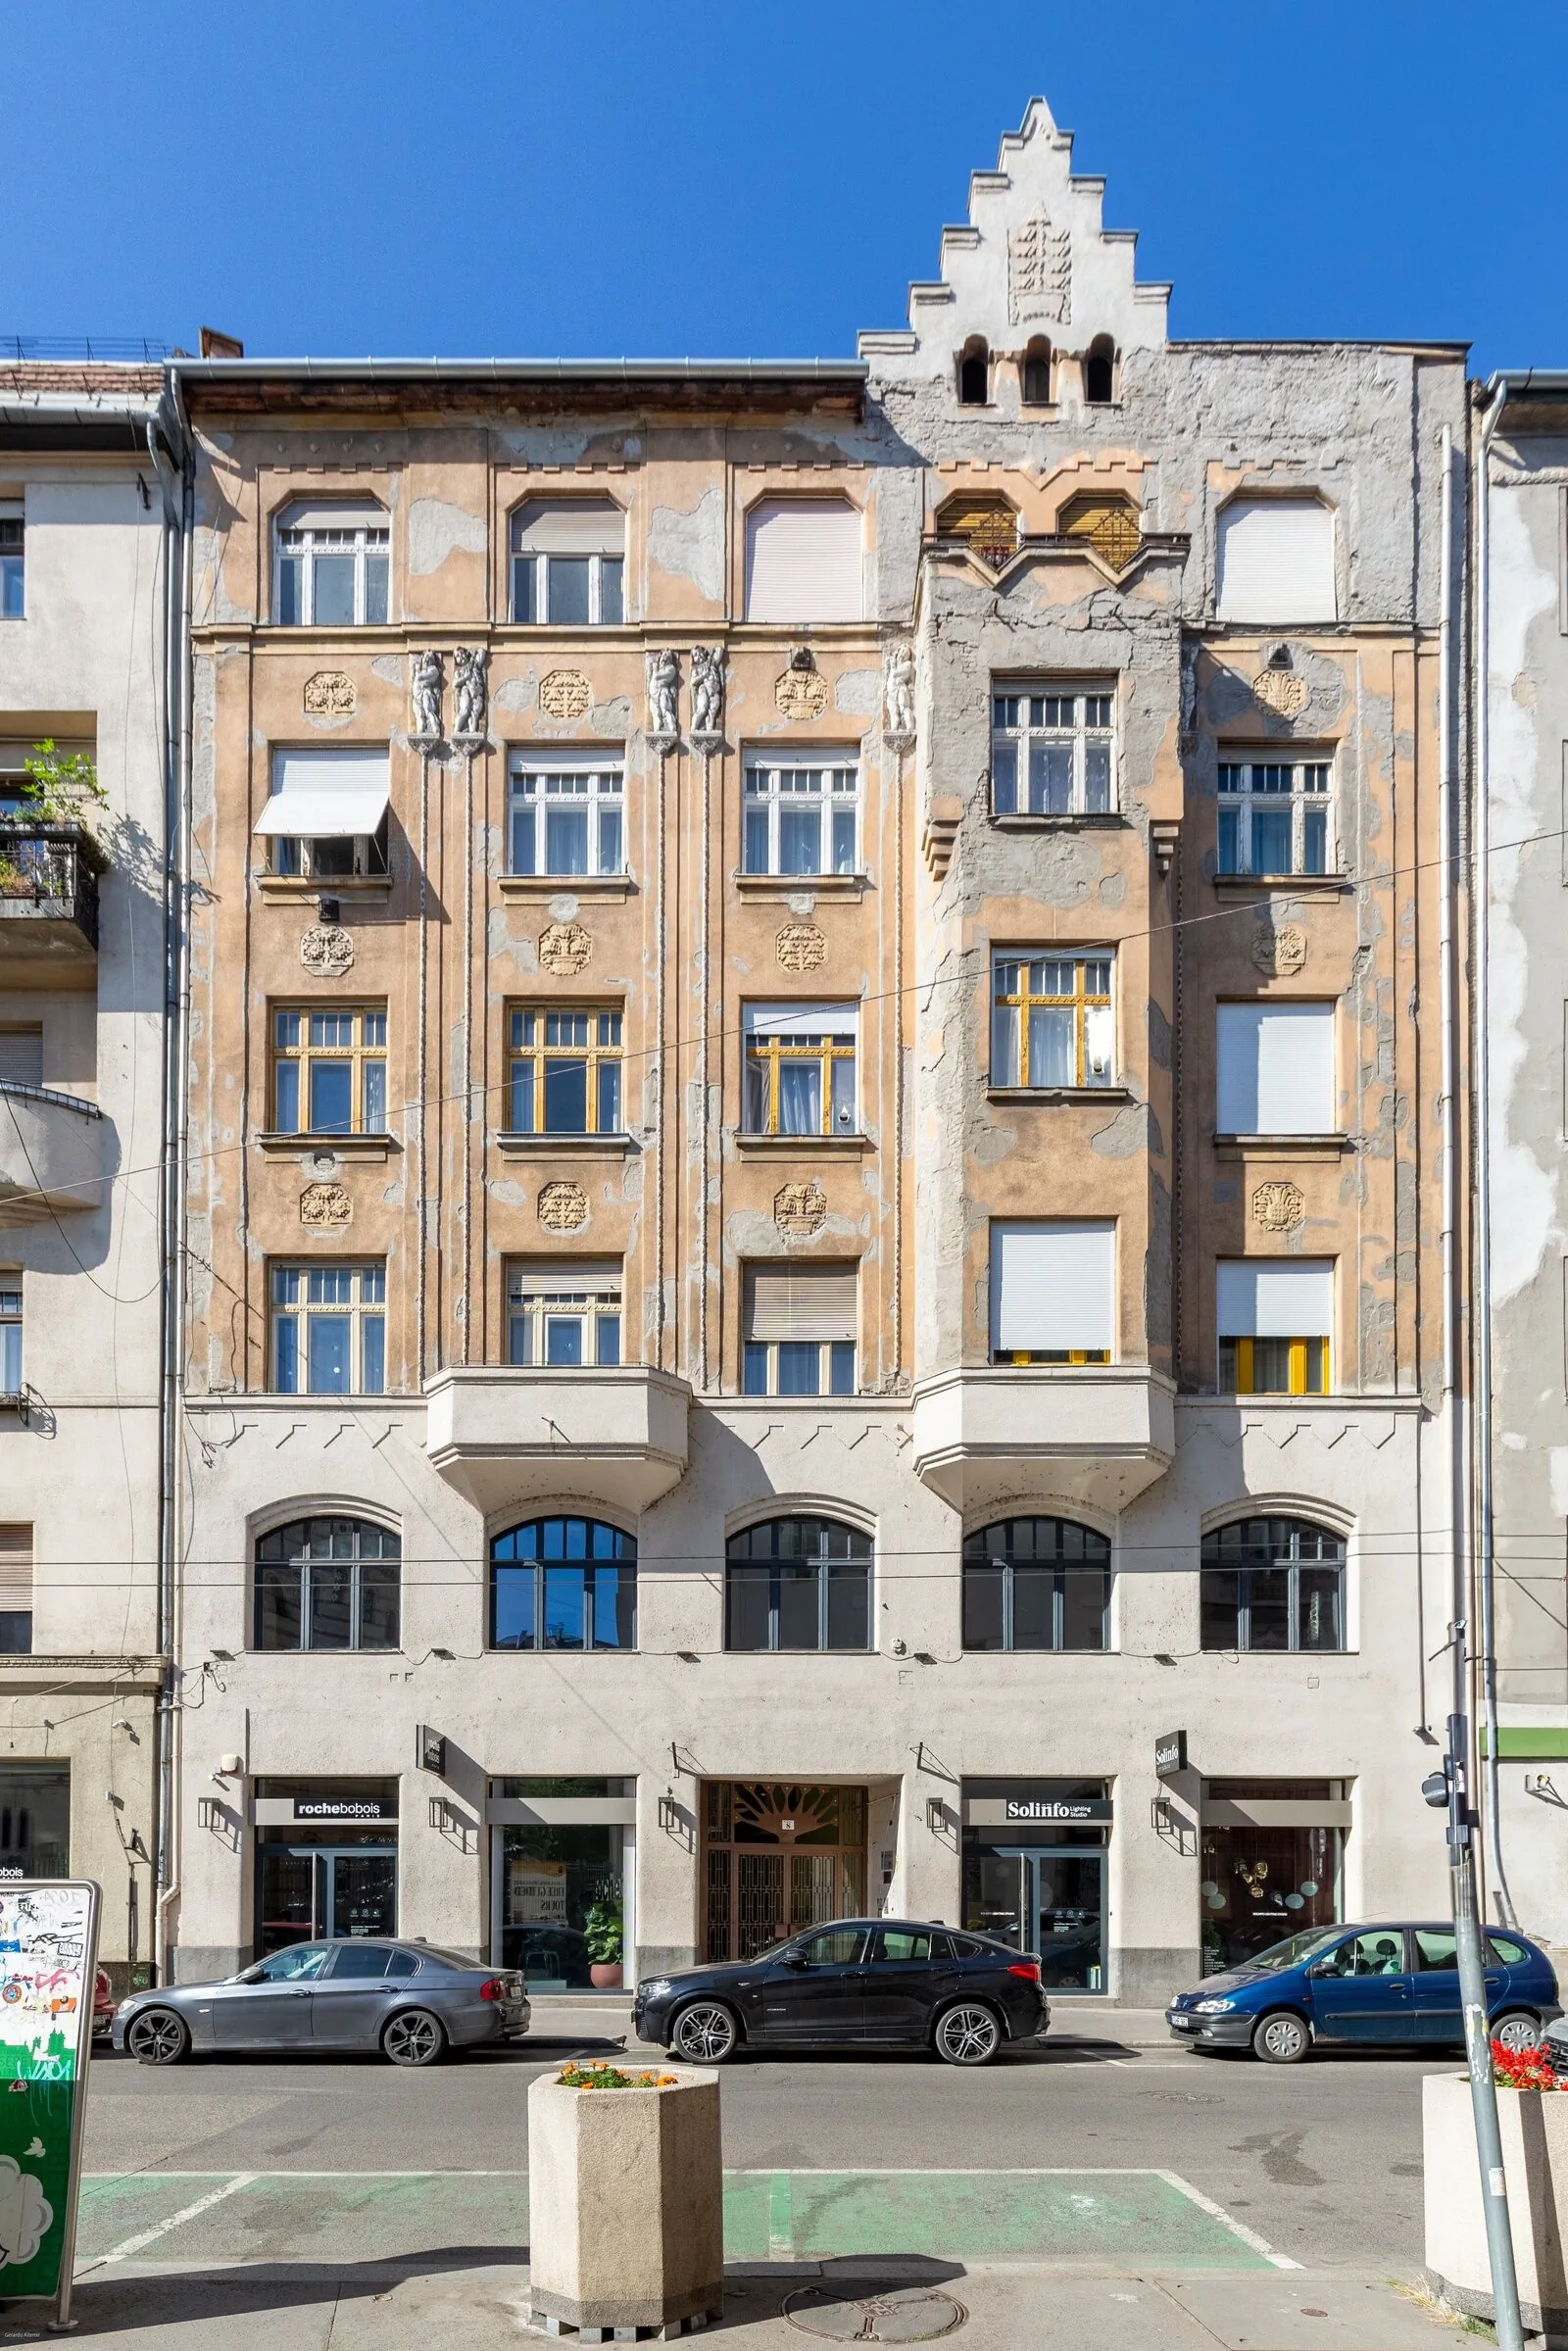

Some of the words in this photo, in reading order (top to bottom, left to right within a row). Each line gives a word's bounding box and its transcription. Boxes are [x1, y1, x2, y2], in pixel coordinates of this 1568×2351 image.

[1156, 1744, 1179, 1765] Solinfo
[298, 1802, 381, 1815] rochebobois
[1006, 1801, 1070, 1818] Solinfo
[0, 1867, 24, 1877] bois
